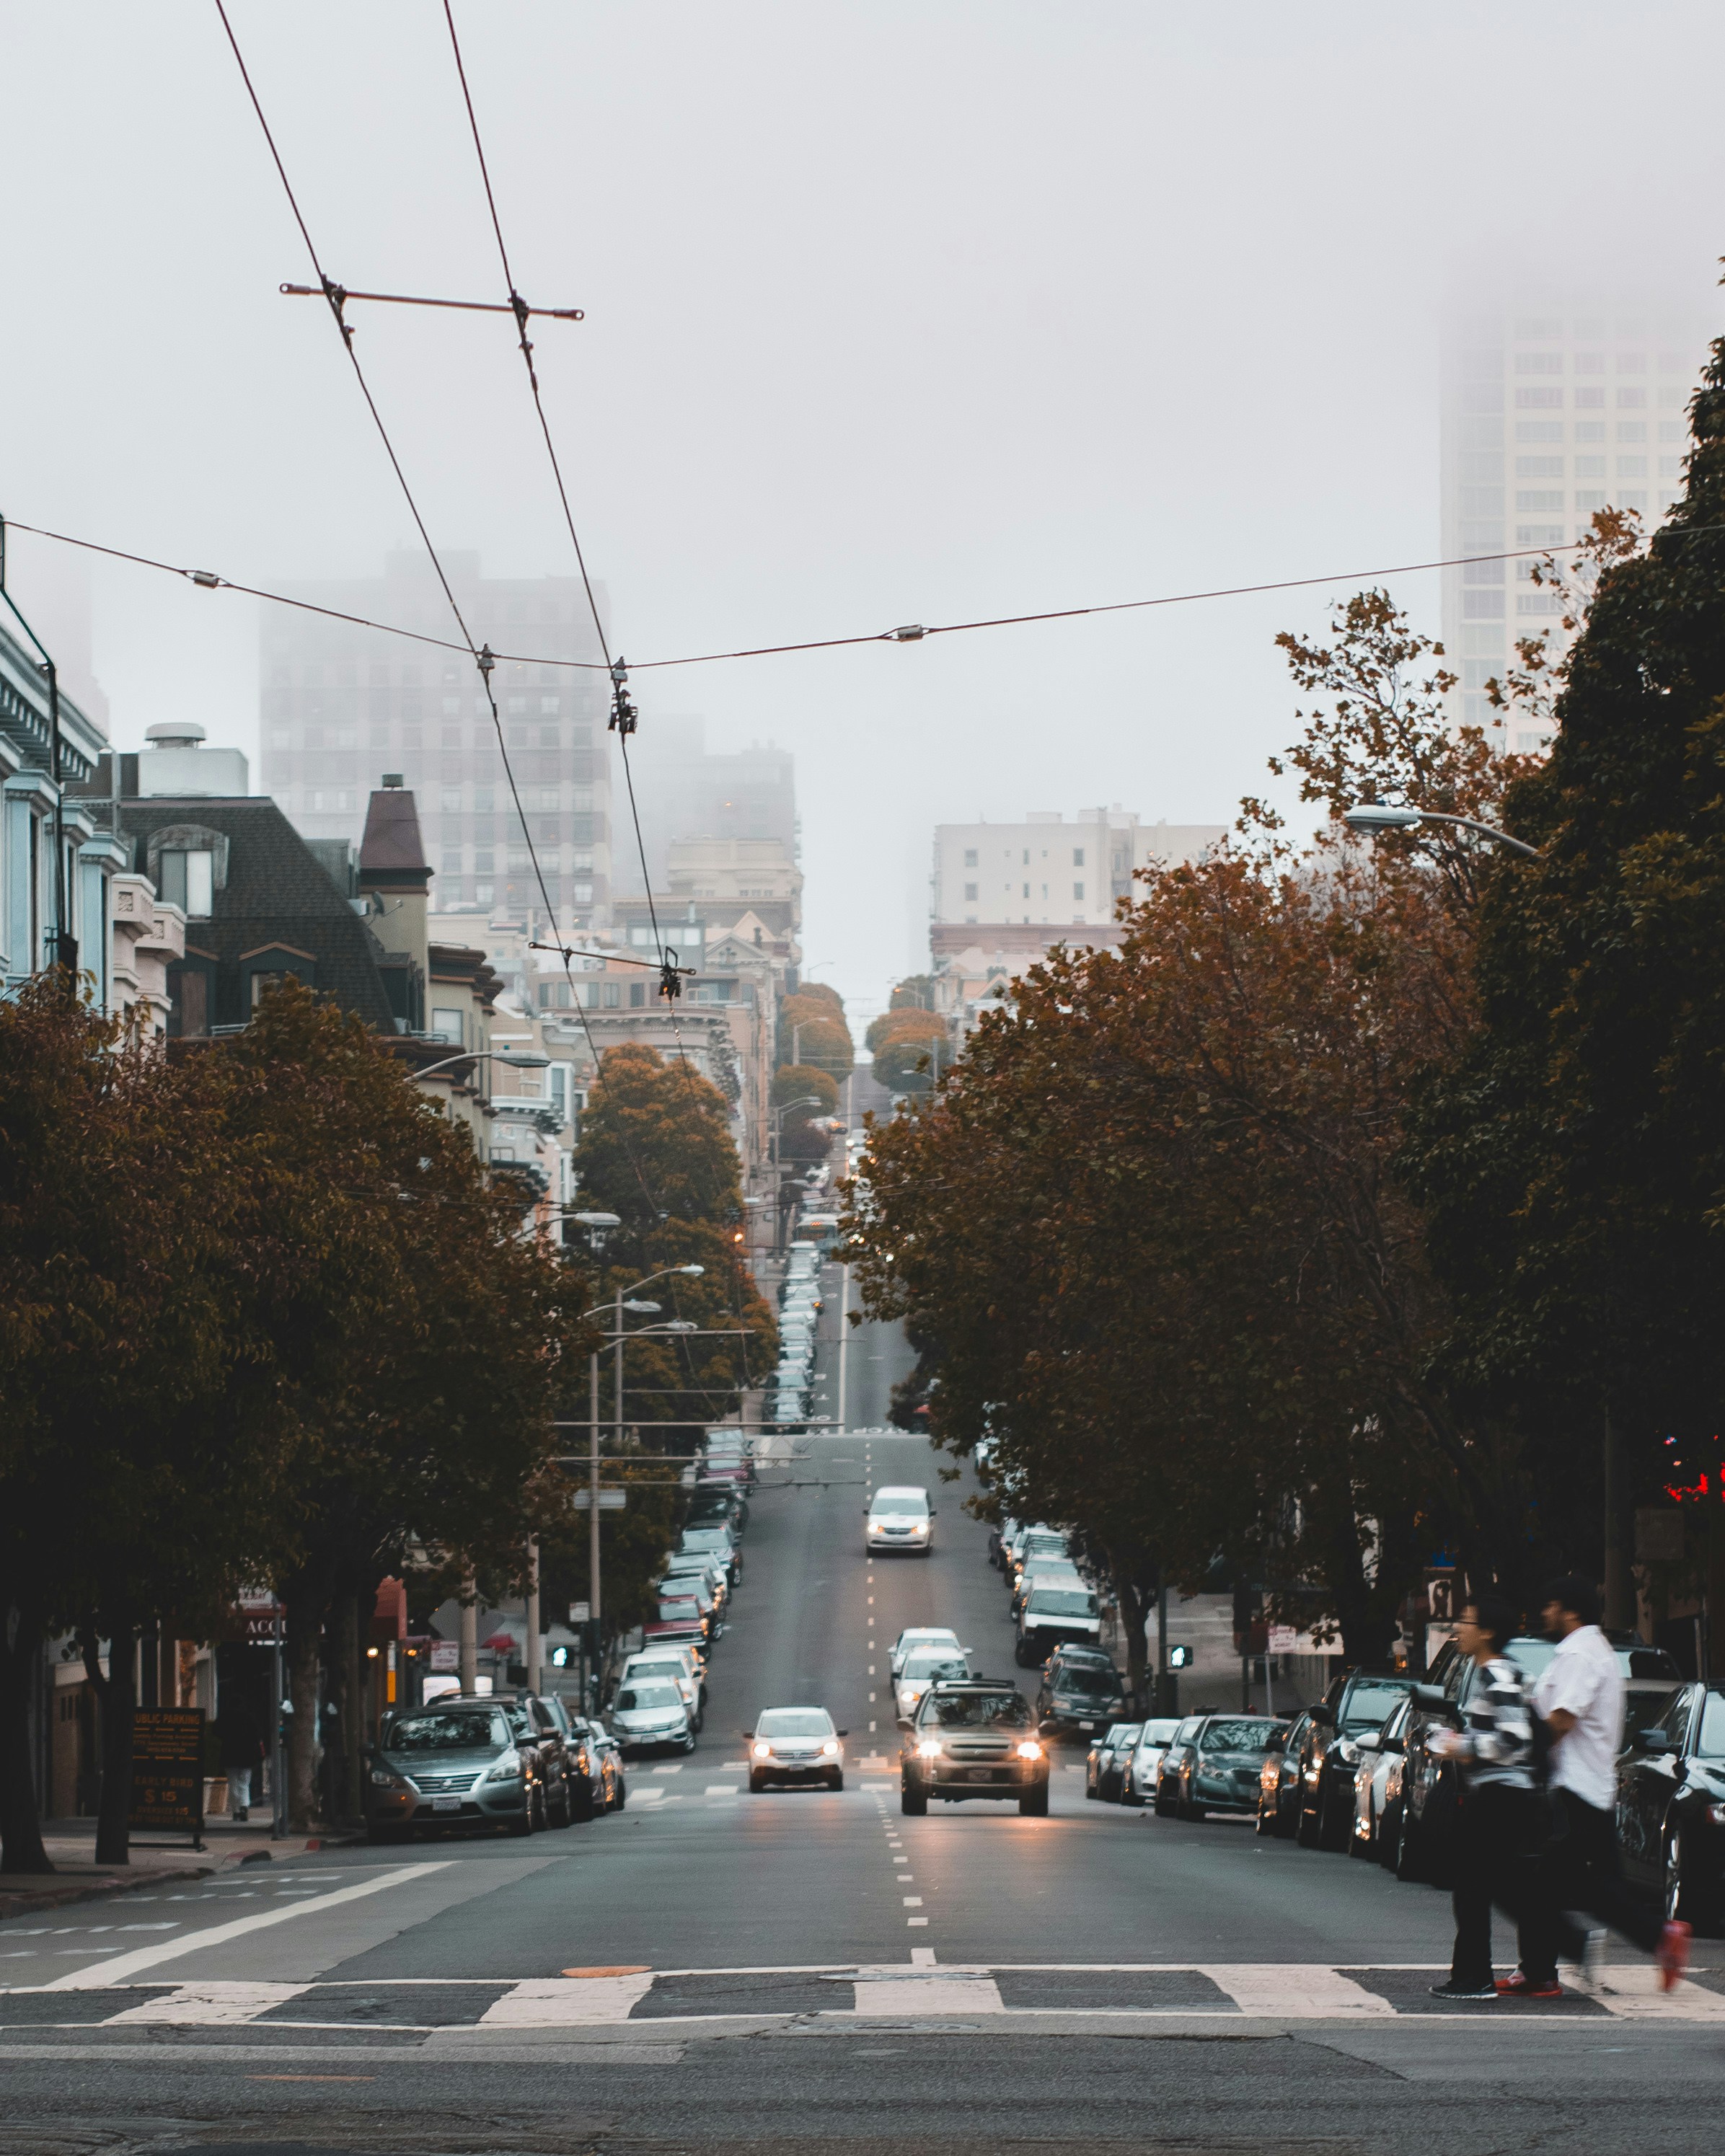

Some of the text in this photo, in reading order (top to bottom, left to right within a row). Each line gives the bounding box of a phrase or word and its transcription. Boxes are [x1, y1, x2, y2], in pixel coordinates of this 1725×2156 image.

[134, 1713, 200, 1725] UBLIC PARKING
[134, 1776, 193, 1788] EARLY BIRD
[162, 1790, 177, 1802] 15
